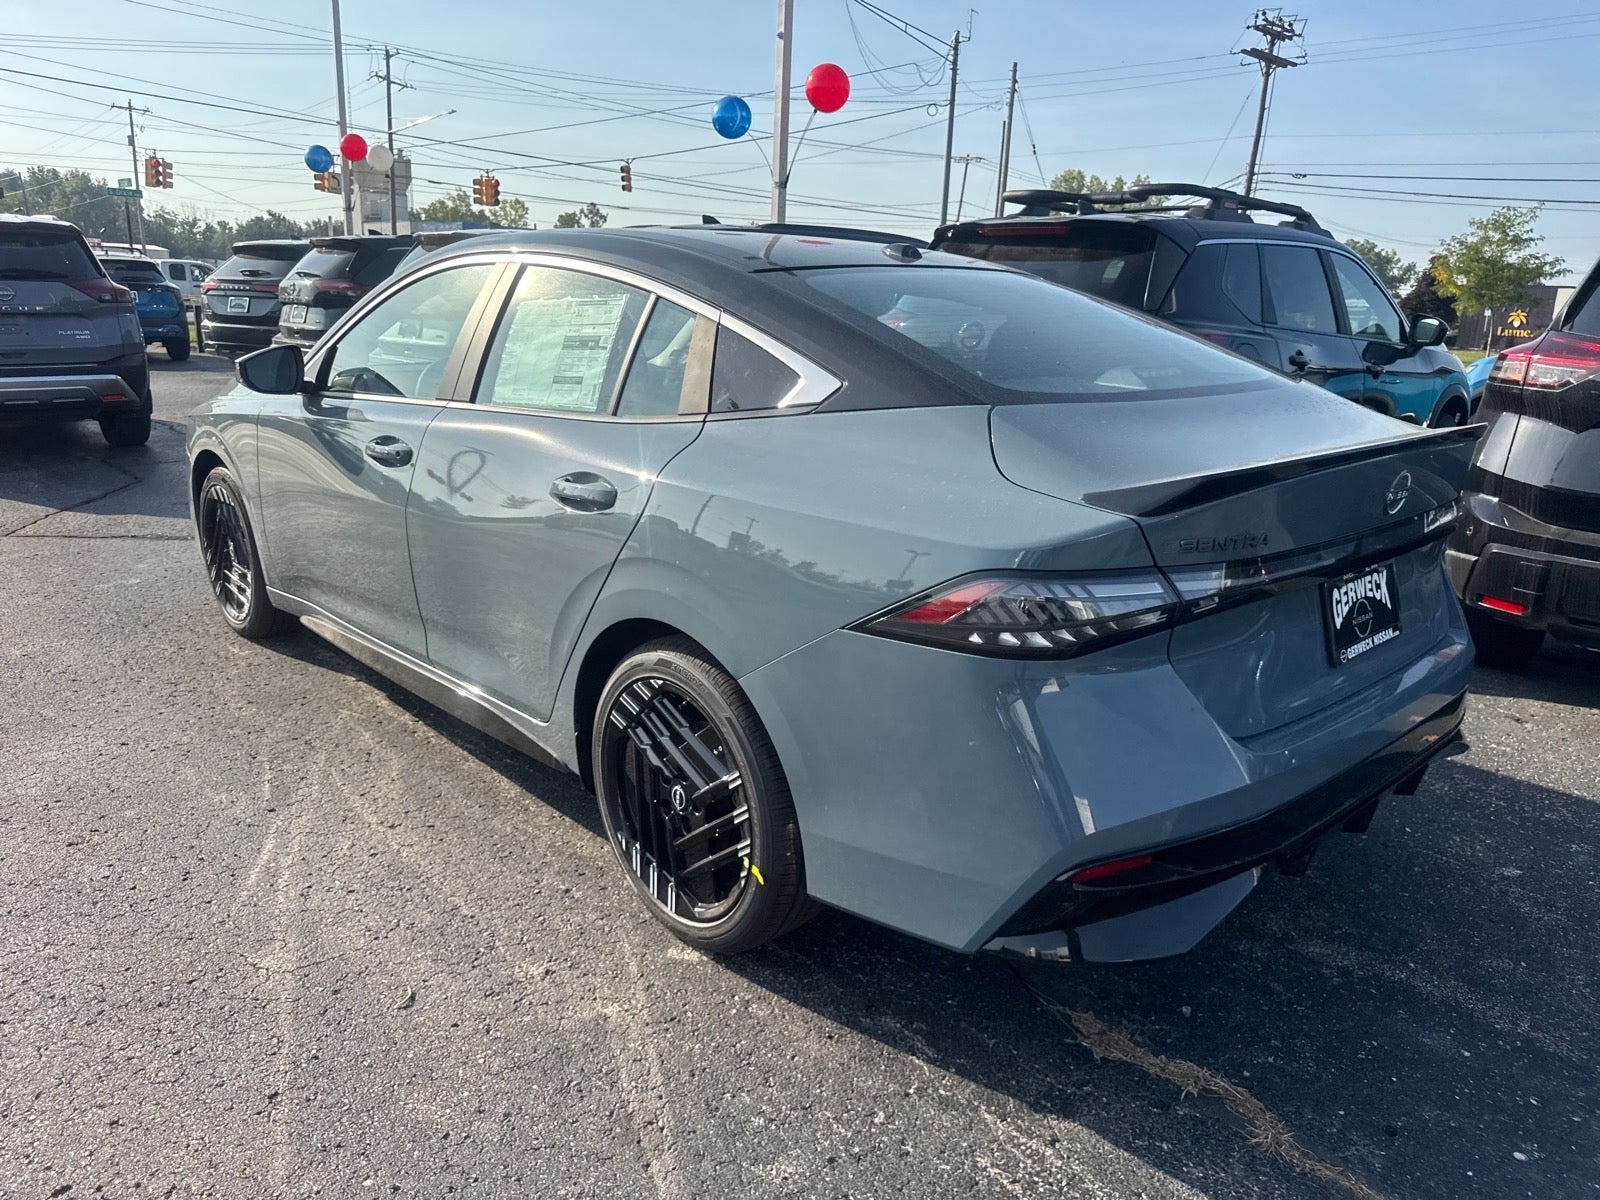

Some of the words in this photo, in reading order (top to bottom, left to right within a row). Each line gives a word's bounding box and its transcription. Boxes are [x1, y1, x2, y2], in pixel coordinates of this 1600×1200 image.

[1177, 532, 1269, 553] SENTRA
[1332, 569, 1392, 630] GERWECK
[1352, 611, 1374, 626] NISSAN
[1346, 638, 1374, 660] GERWECK
